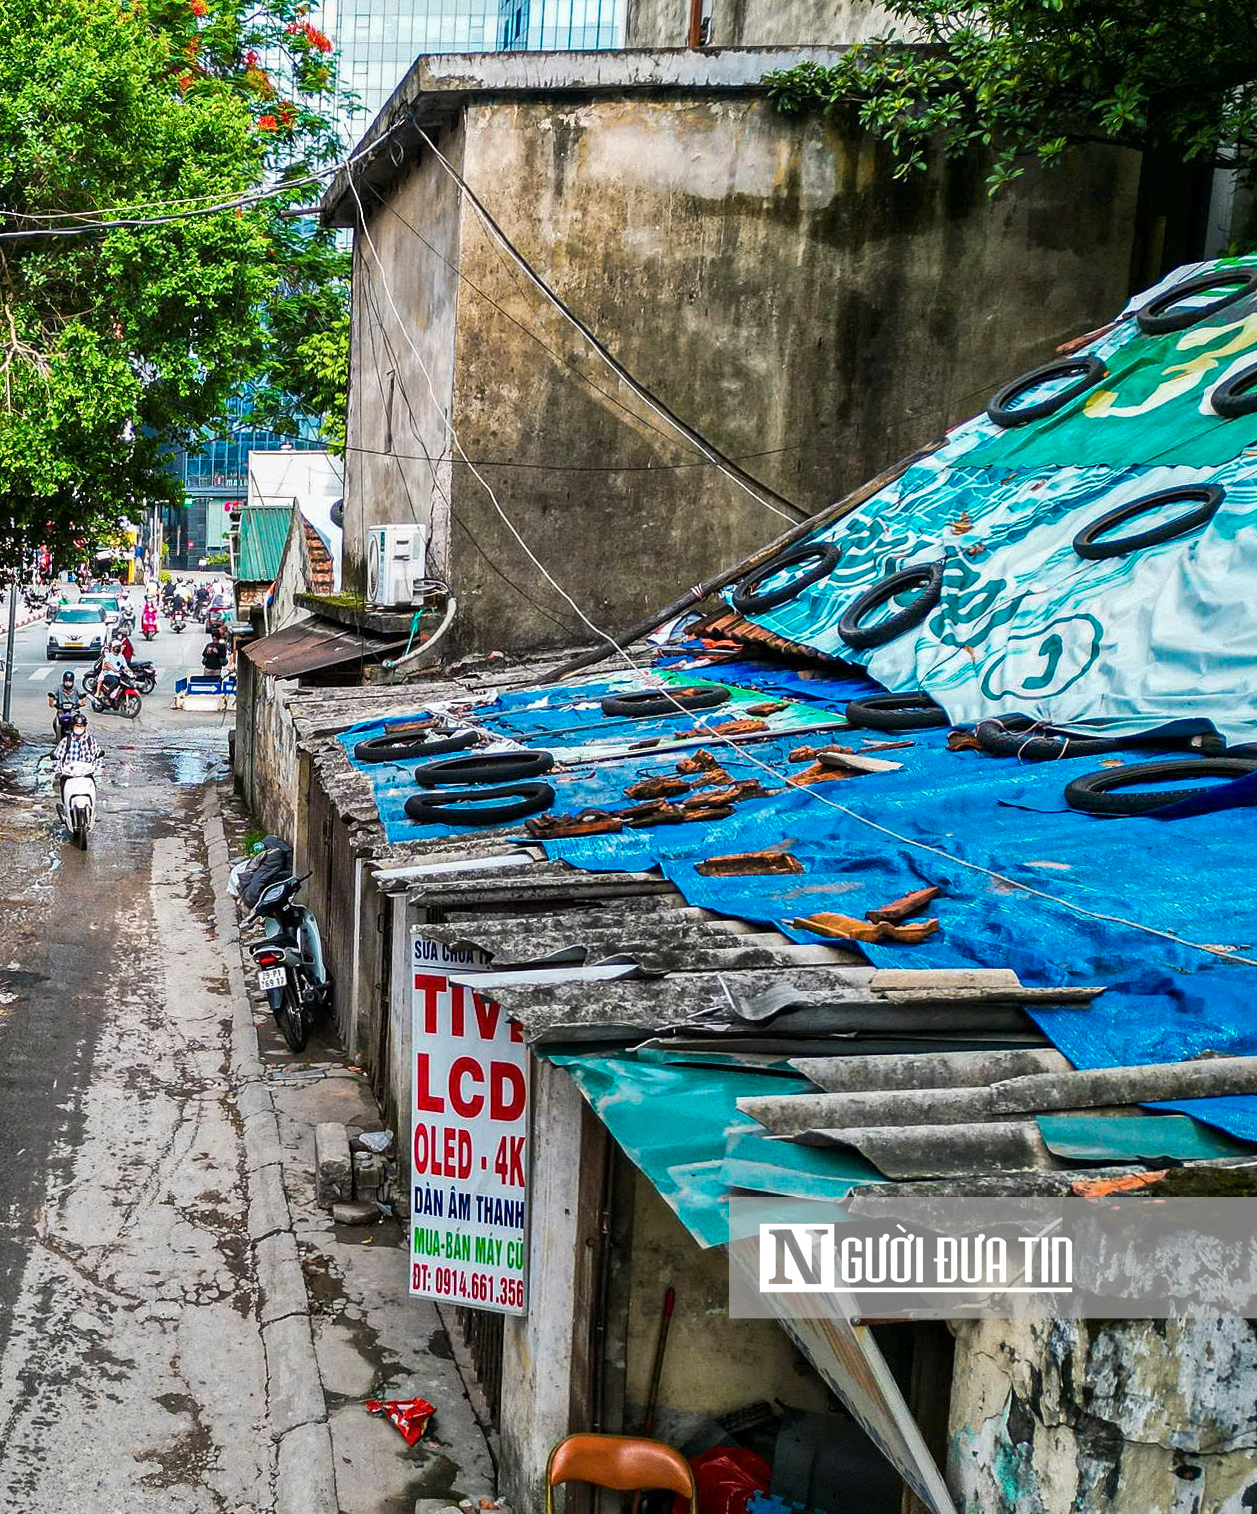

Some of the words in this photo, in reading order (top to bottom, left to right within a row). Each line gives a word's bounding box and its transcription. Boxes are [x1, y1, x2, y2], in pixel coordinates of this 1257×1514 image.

[416, 1053, 527, 1123] LCD
[414, 1122, 472, 1180] OLED
[495, 1134, 526, 1188] 4K
[414, 1182, 443, 1217] DÀN
[448, 1185, 471, 1221] ÂM
[476, 1195, 525, 1229] THANH
[414, 1226, 471, 1262] MUA-BÁN
[475, 1232, 503, 1266] MÁY
[507, 1237, 524, 1270] CŨ
[412, 1263, 431, 1292] ĐT:
[435, 1266, 524, 1308] 0914.661.356
